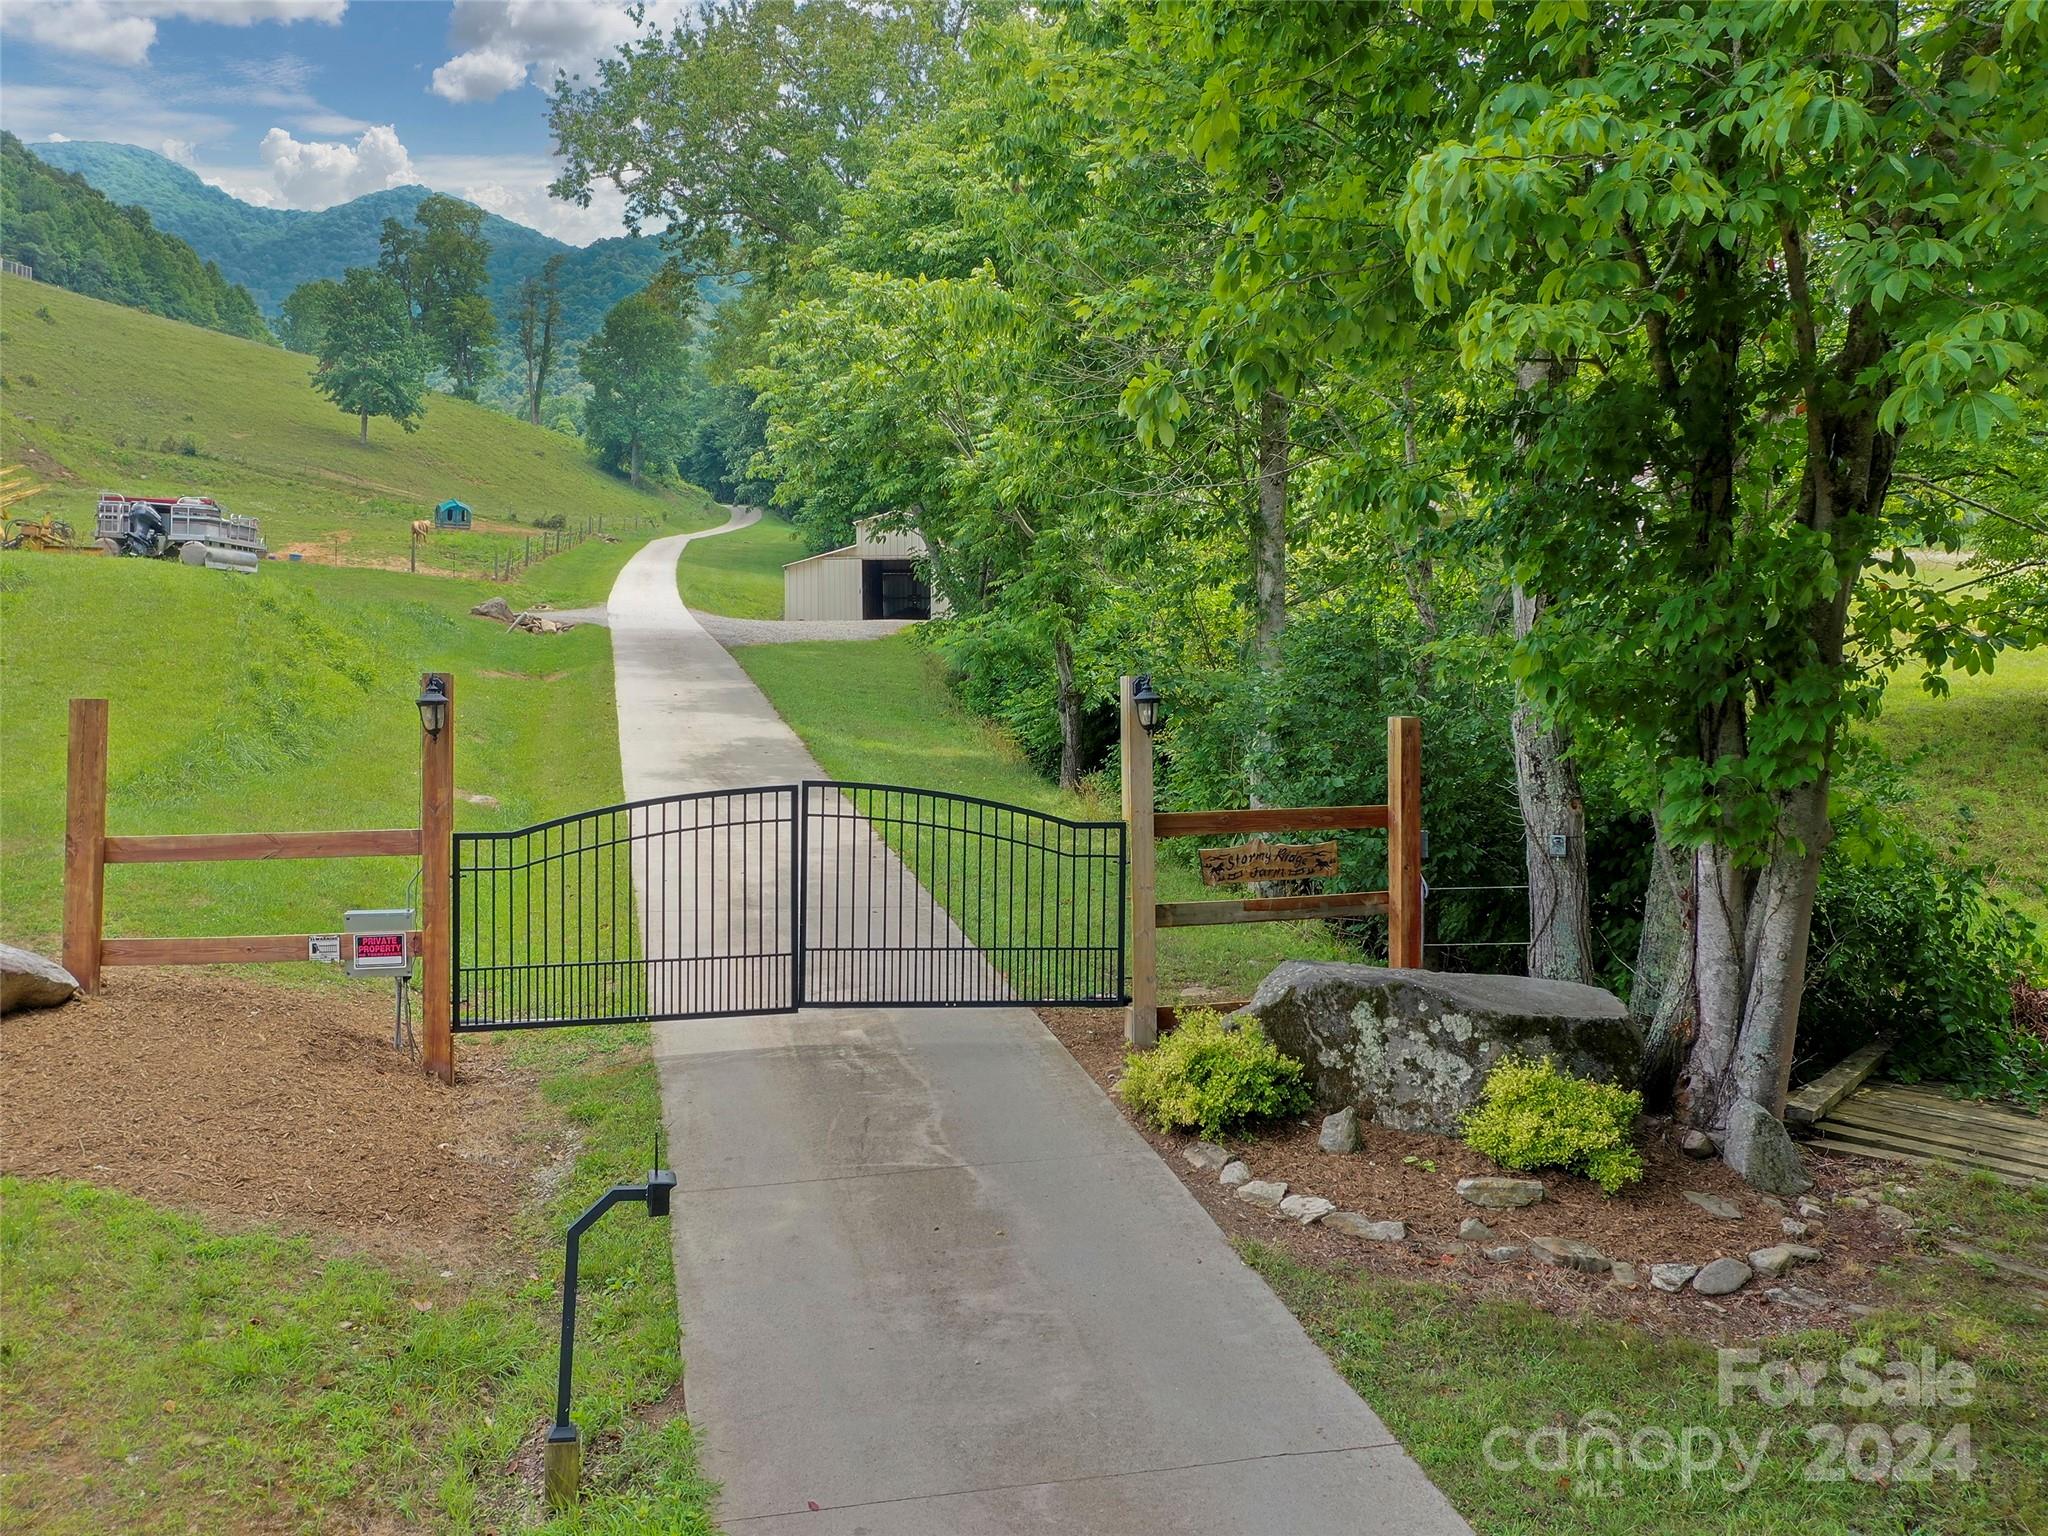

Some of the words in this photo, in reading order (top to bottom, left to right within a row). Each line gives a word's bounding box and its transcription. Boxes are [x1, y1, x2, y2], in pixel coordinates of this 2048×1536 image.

[1226, 852, 1271, 871] Stormy
[1274, 848, 1307, 869] Ridge
[1250, 867, 1285, 878] Farm
[362, 936, 398, 945] PRIVATE
[358, 944, 401, 953] PROPERTY
